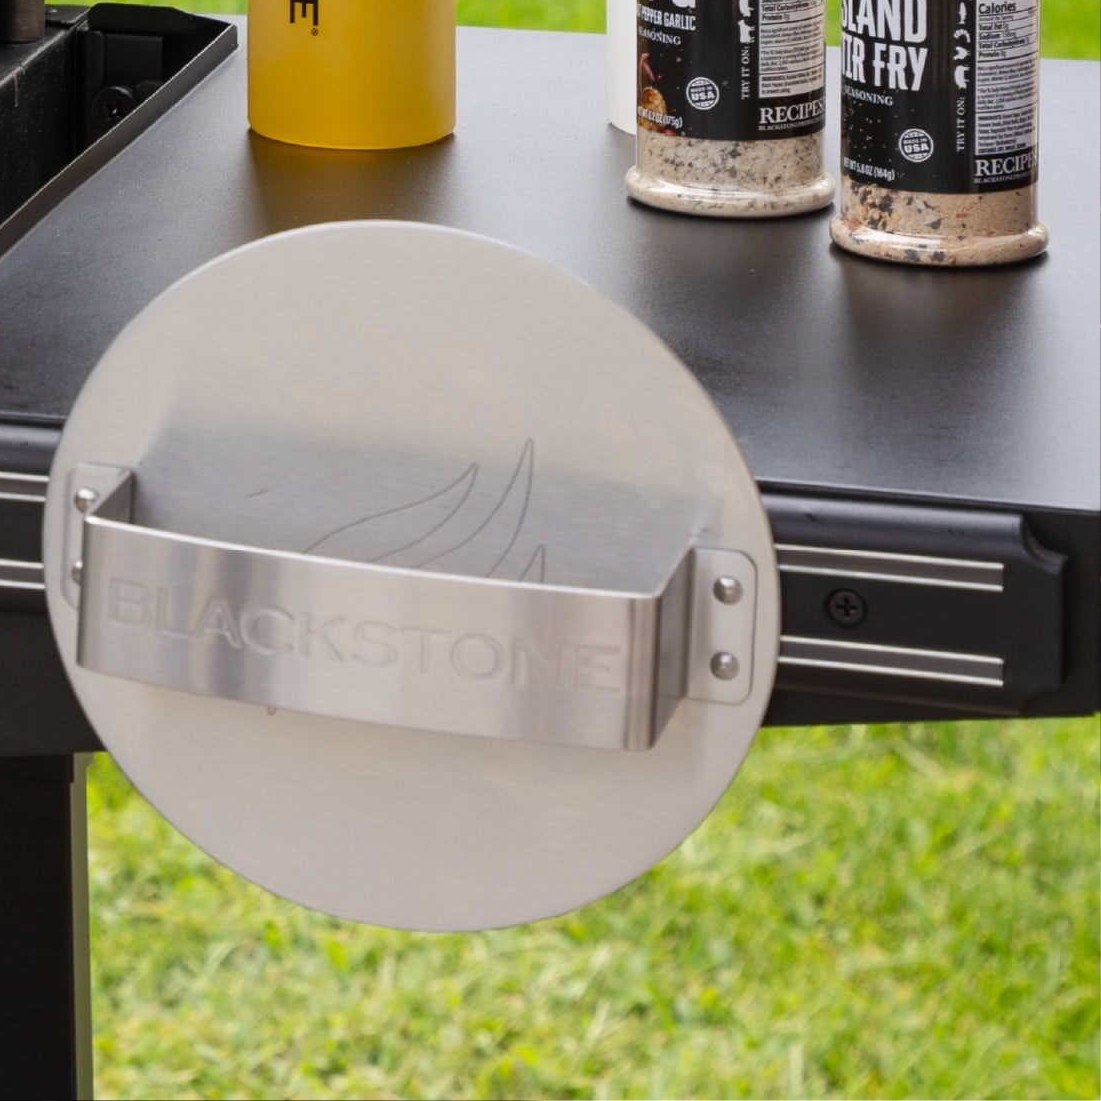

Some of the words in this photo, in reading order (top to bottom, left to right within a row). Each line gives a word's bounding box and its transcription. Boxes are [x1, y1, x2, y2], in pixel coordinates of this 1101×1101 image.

[978, 0, 1016, 14] Calories
[641, 5, 662, 25] PEPPER
[664, 11, 697, 31] GARLIC
[841, 30, 866, 84] TIR
[872, 42, 928, 91] FRY
[741, 66, 750, 77] IT
[691, 91, 715, 101] USA
[741, 80, 750, 100] TRY
[956, 118, 965, 129] IT
[903, 143, 930, 153] USA
[956, 131, 965, 152] TRY
[856, 161, 865, 174] 5.8
[865, 164, 873, 176] OZ
[874, 166, 895, 182] (164g)
[975, 153, 1037, 176] RECIPE
[107, 577, 624, 695] BLACKSTONE
